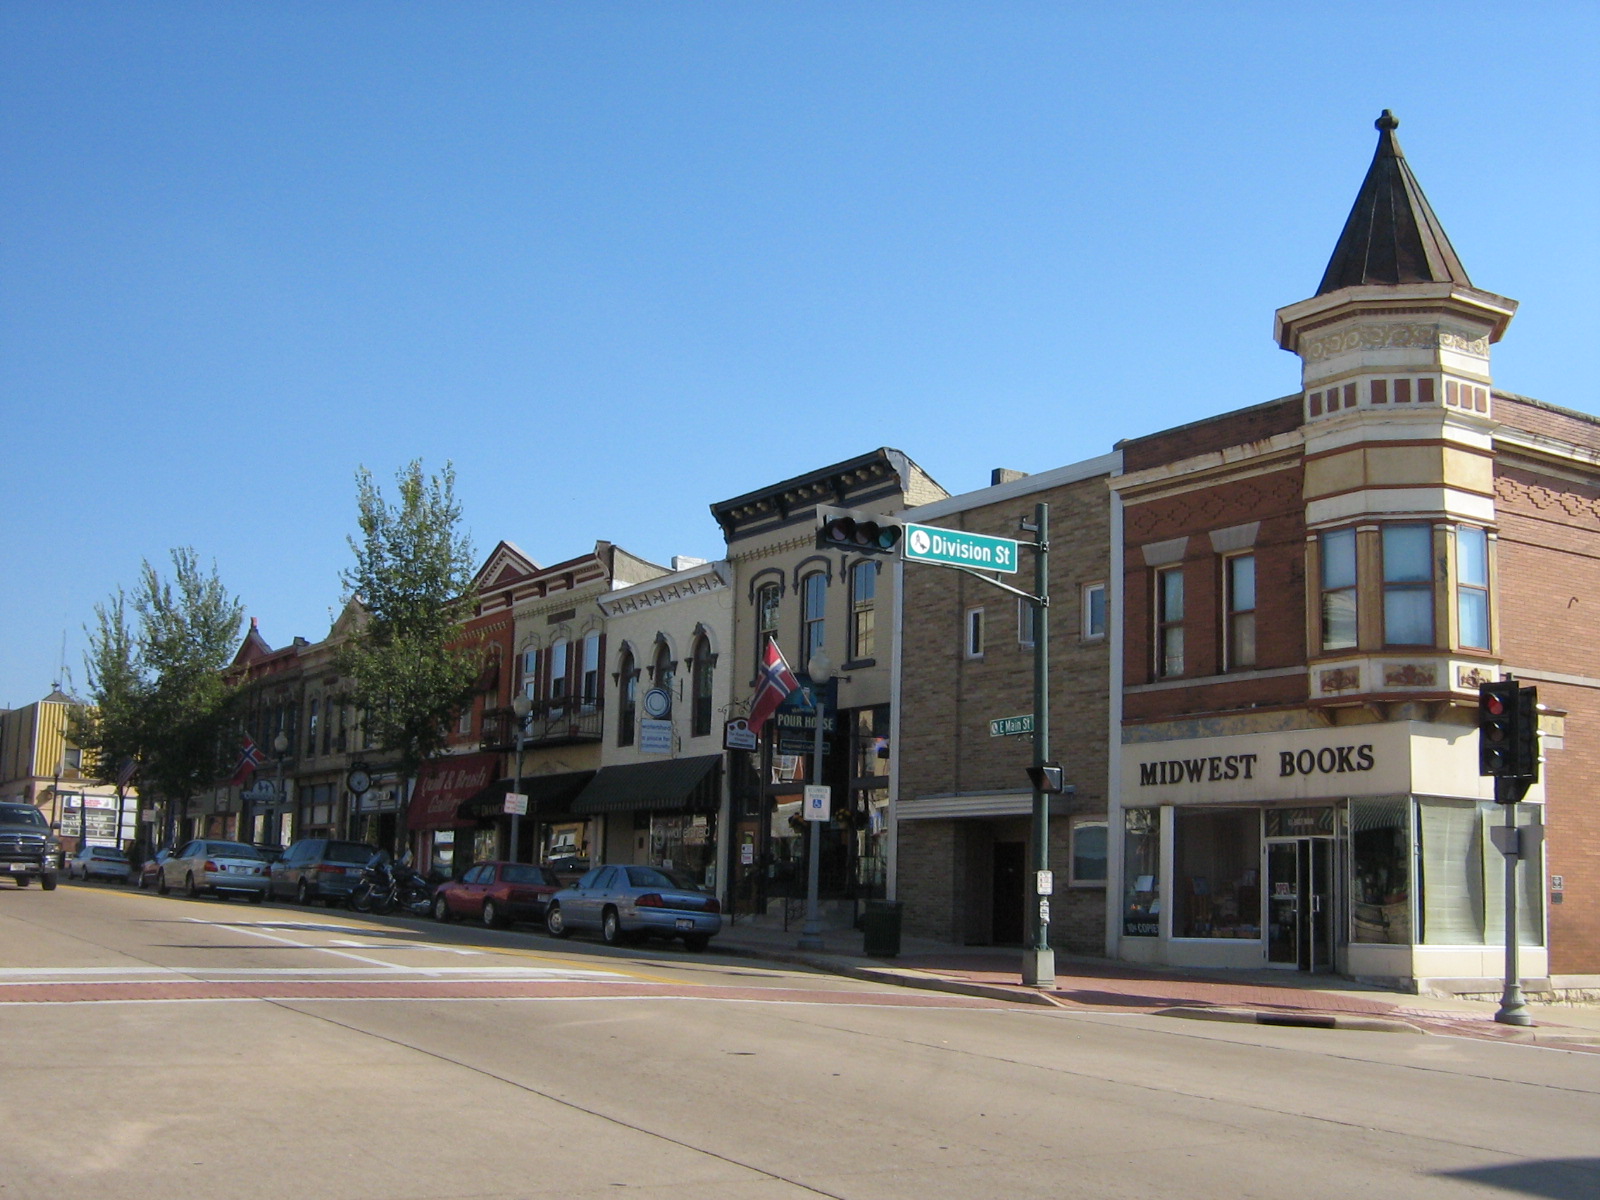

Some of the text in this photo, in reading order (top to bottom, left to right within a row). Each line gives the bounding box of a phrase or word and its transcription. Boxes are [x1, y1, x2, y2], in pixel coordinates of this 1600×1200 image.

[932, 535, 1010, 565] Division St
[777, 713, 833, 731] POUR HOSE
[999, 717, 1031, 733] E Main St
[1140, 745, 1374, 786] MIDWEST BOOKS
[444, 771, 455, 790] &
[454, 766, 486, 789] Brush
[665, 825, 710, 839] watershed
[1137, 922, 1160, 933] COPIE
